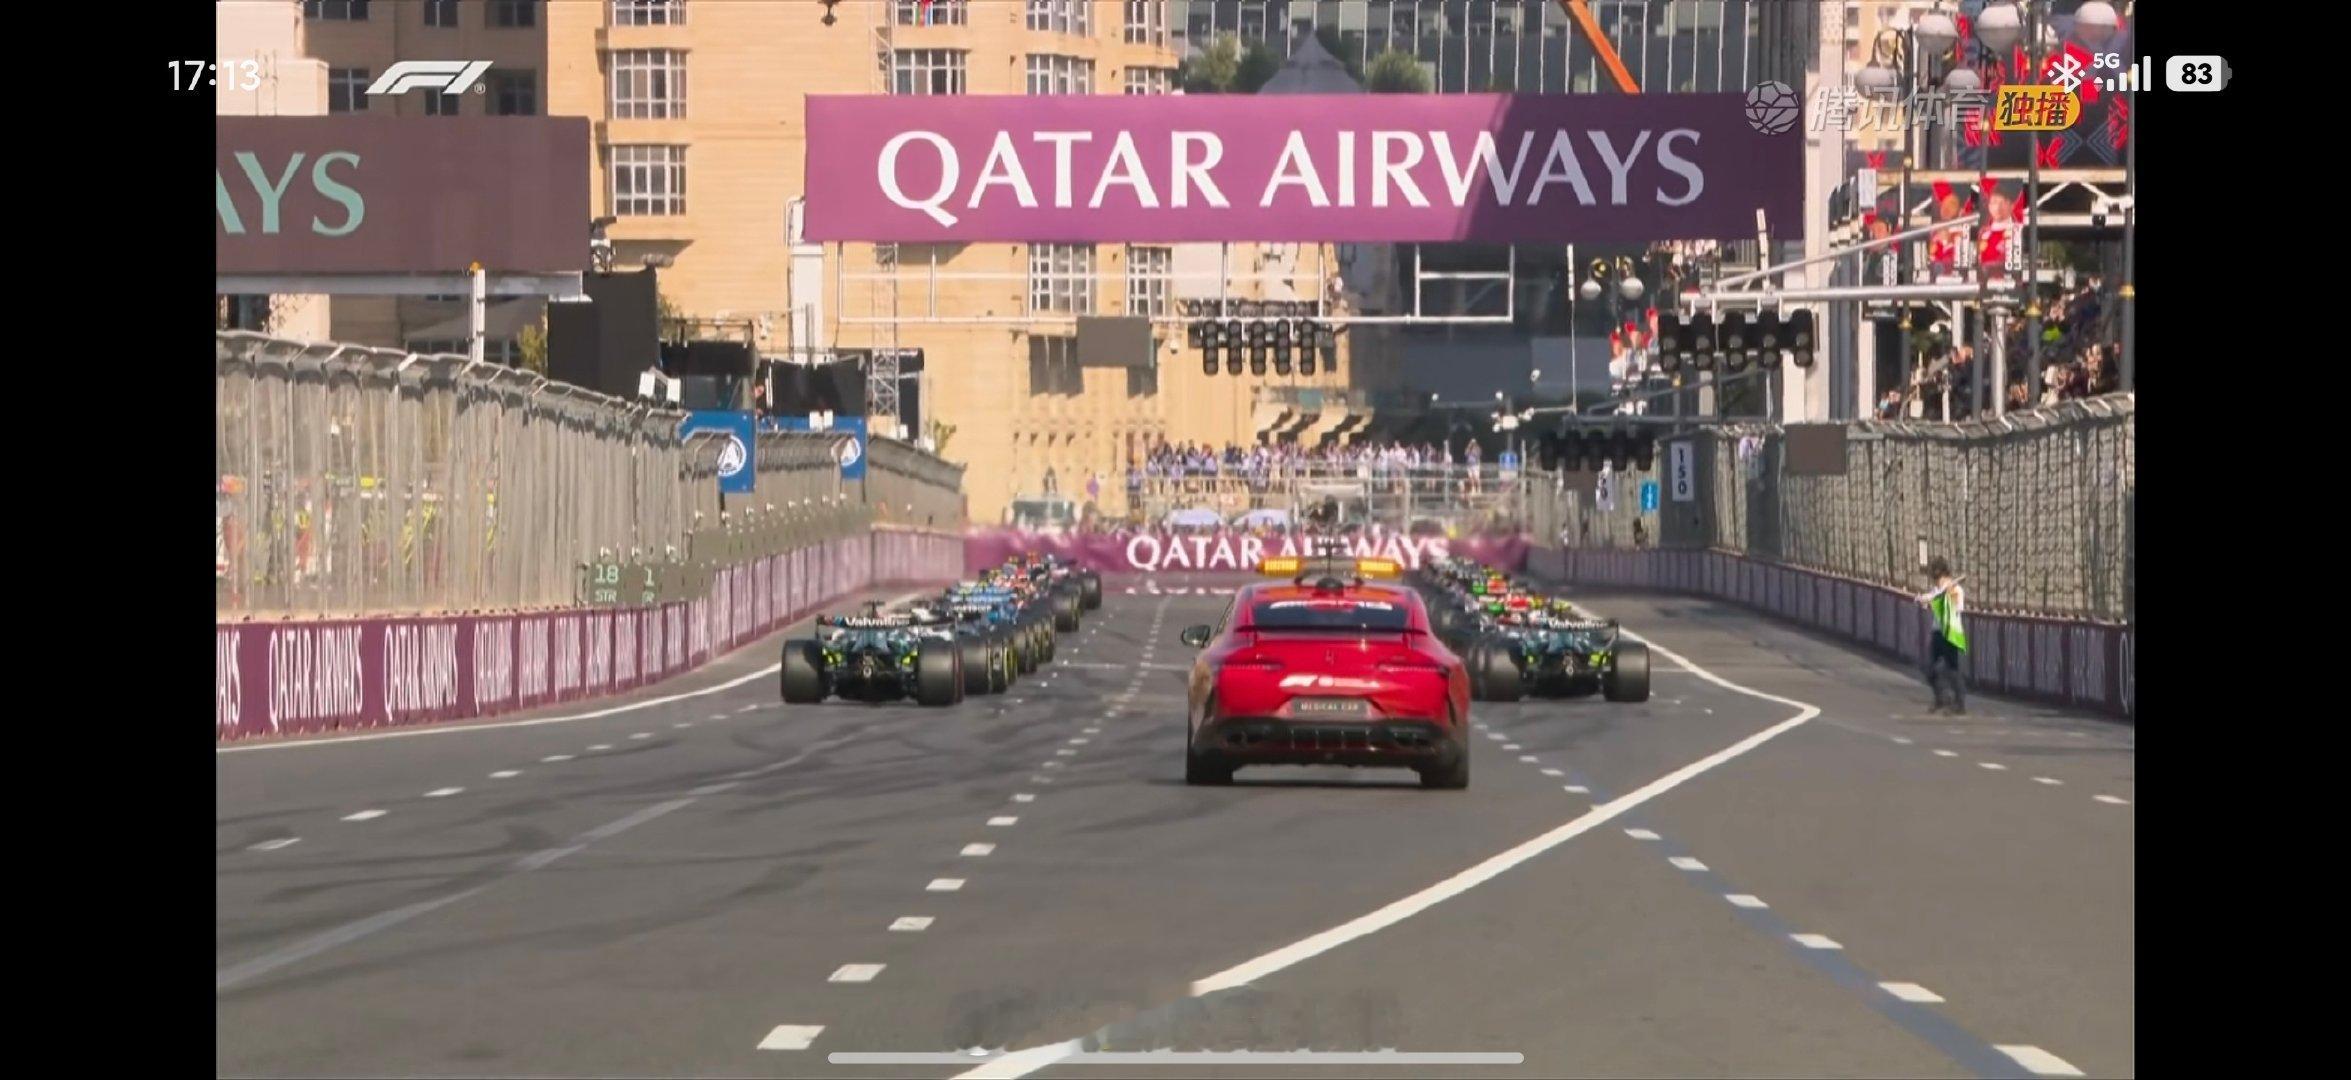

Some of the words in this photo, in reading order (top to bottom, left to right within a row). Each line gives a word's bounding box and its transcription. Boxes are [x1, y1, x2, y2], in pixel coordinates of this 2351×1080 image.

[877, 130, 1231, 228] QATAR
[1259, 128, 1706, 208] AIRWAYS
[1677, 448, 1688, 495] 150
[594, 564, 619, 584] 18
[1126, 535, 1264, 571] QATAR
[268, 627, 312, 732] QATAR
